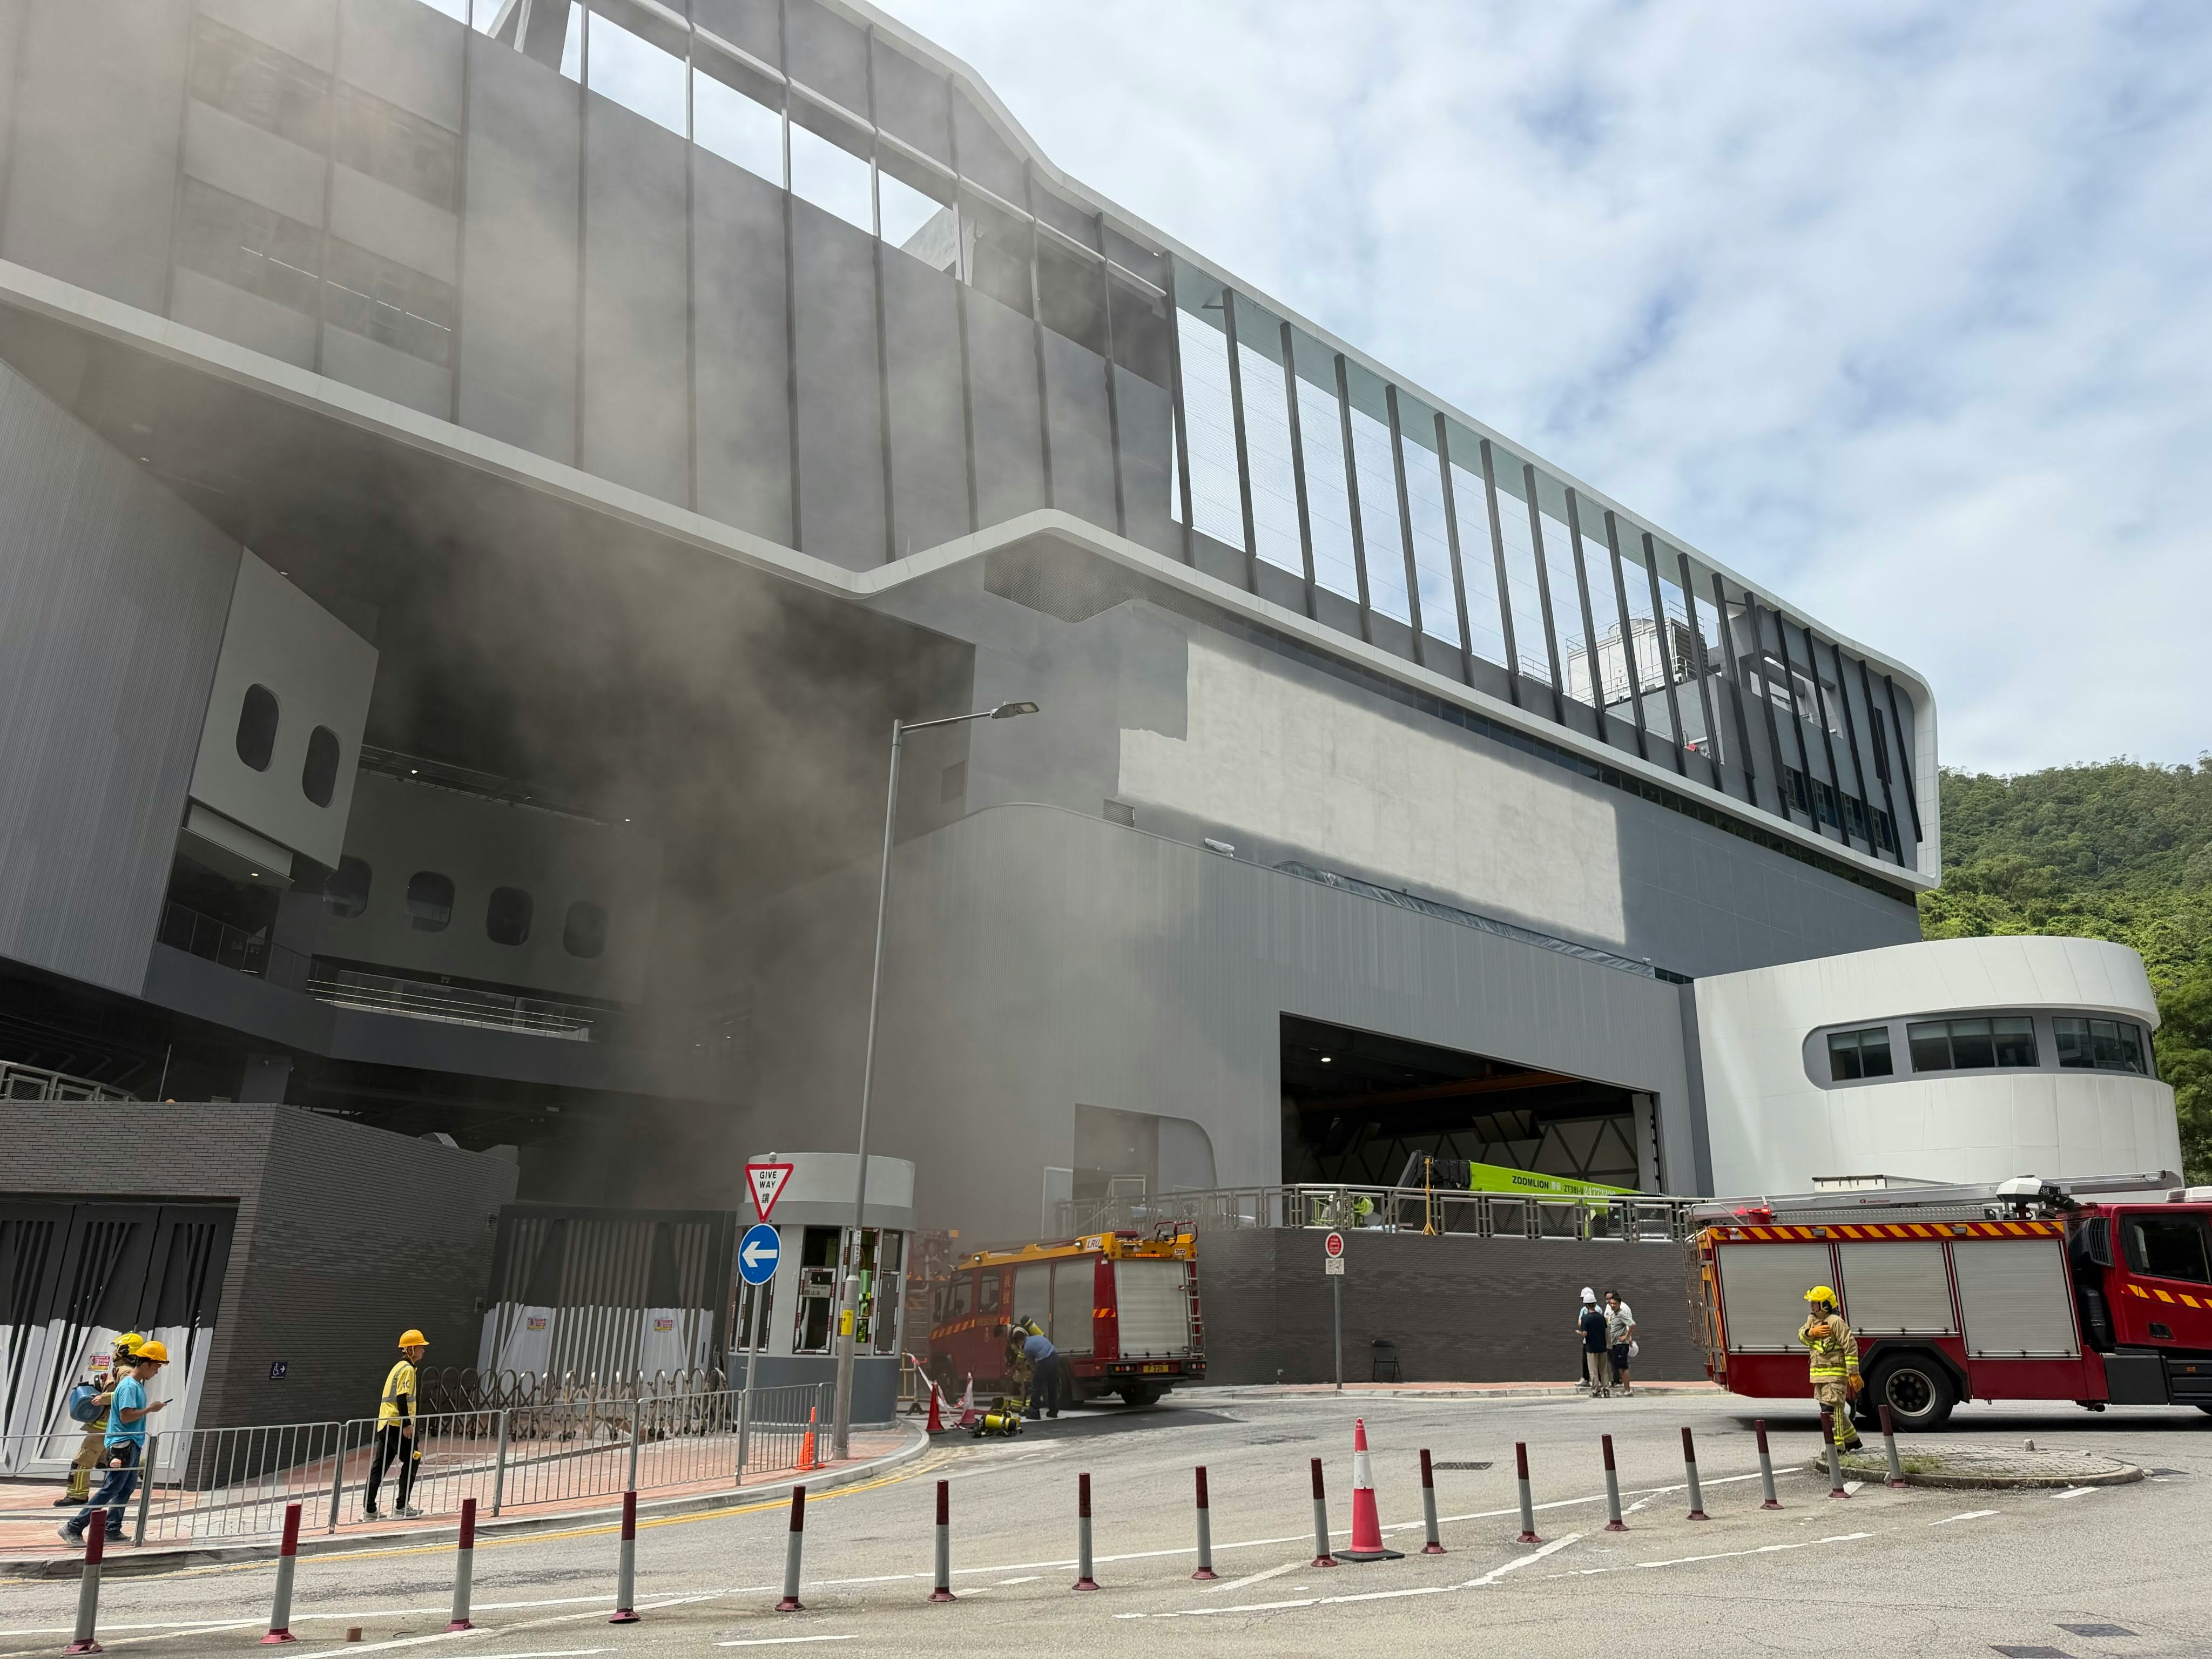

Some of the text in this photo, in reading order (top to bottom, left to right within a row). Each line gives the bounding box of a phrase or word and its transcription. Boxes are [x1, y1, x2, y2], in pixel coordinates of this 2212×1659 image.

[760, 1171, 777, 1179] GIVE
[1512, 1175, 1549, 1190] ZOOMLION
[761, 1193, 770, 1203] 讓
[1087, 1239, 1101, 1248] LRU
[976, 1317, 999, 1326] RESCUE
